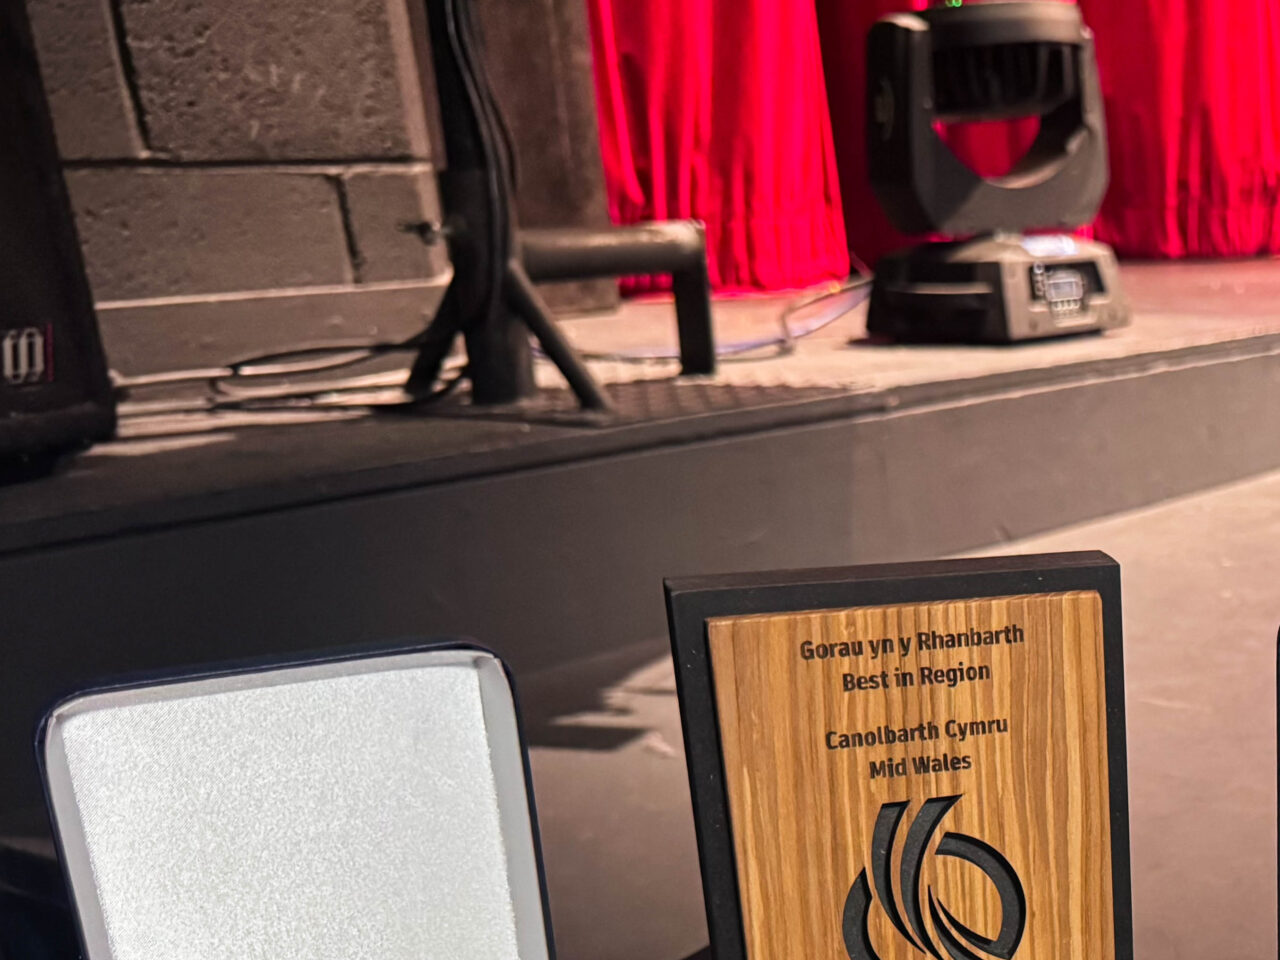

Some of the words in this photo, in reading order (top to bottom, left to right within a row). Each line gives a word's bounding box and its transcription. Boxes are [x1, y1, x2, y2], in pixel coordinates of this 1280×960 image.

[800, 637, 863, 661] Gorau
[869, 635, 895, 659] yn
[900, 637, 911, 657] y
[917, 624, 1024, 651] Rhanbarth
[842, 669, 889, 692] Best
[894, 664, 914, 687] in
[920, 661, 991, 687] Region
[825, 722, 939, 750] Canolbarth
[945, 718, 1008, 742] Cymru
[869, 756, 907, 779] Mid
[912, 753, 972, 775] Wales
